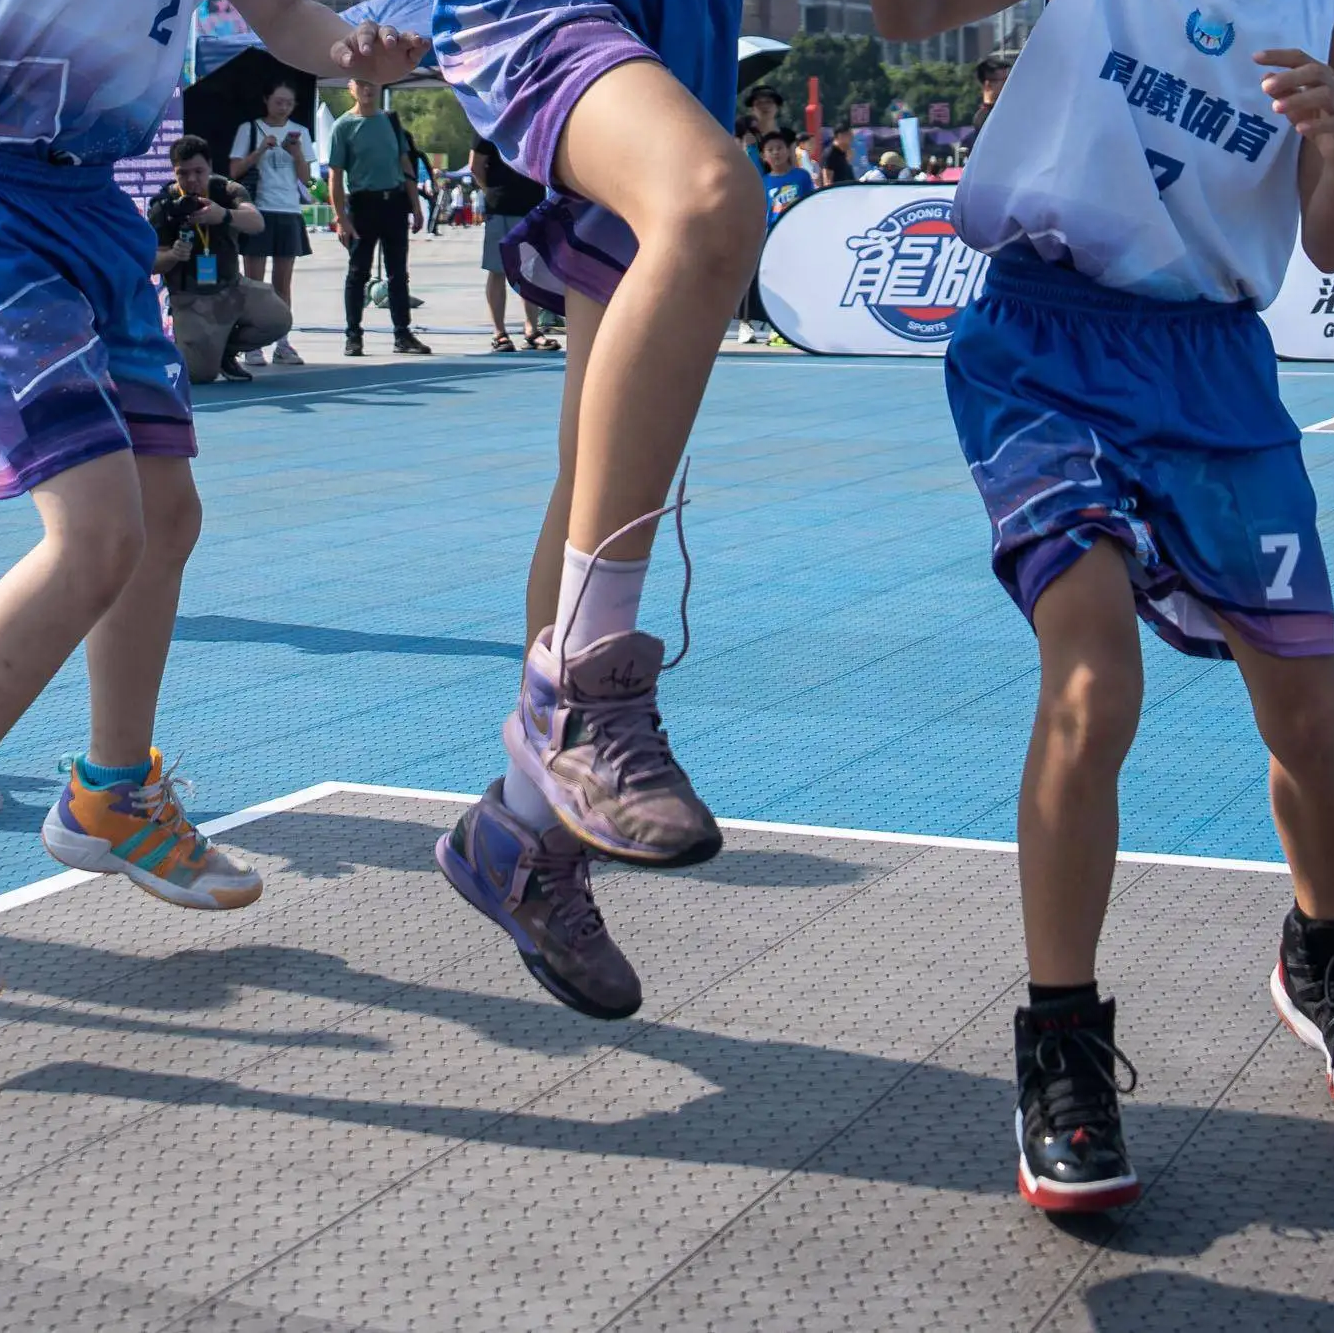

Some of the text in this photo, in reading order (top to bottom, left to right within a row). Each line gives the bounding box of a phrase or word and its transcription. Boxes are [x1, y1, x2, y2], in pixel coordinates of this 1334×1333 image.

[900, 207, 943, 226] LOONG
[907, 320, 948, 333] SPORTS
[1259, 532, 1302, 601] 7
